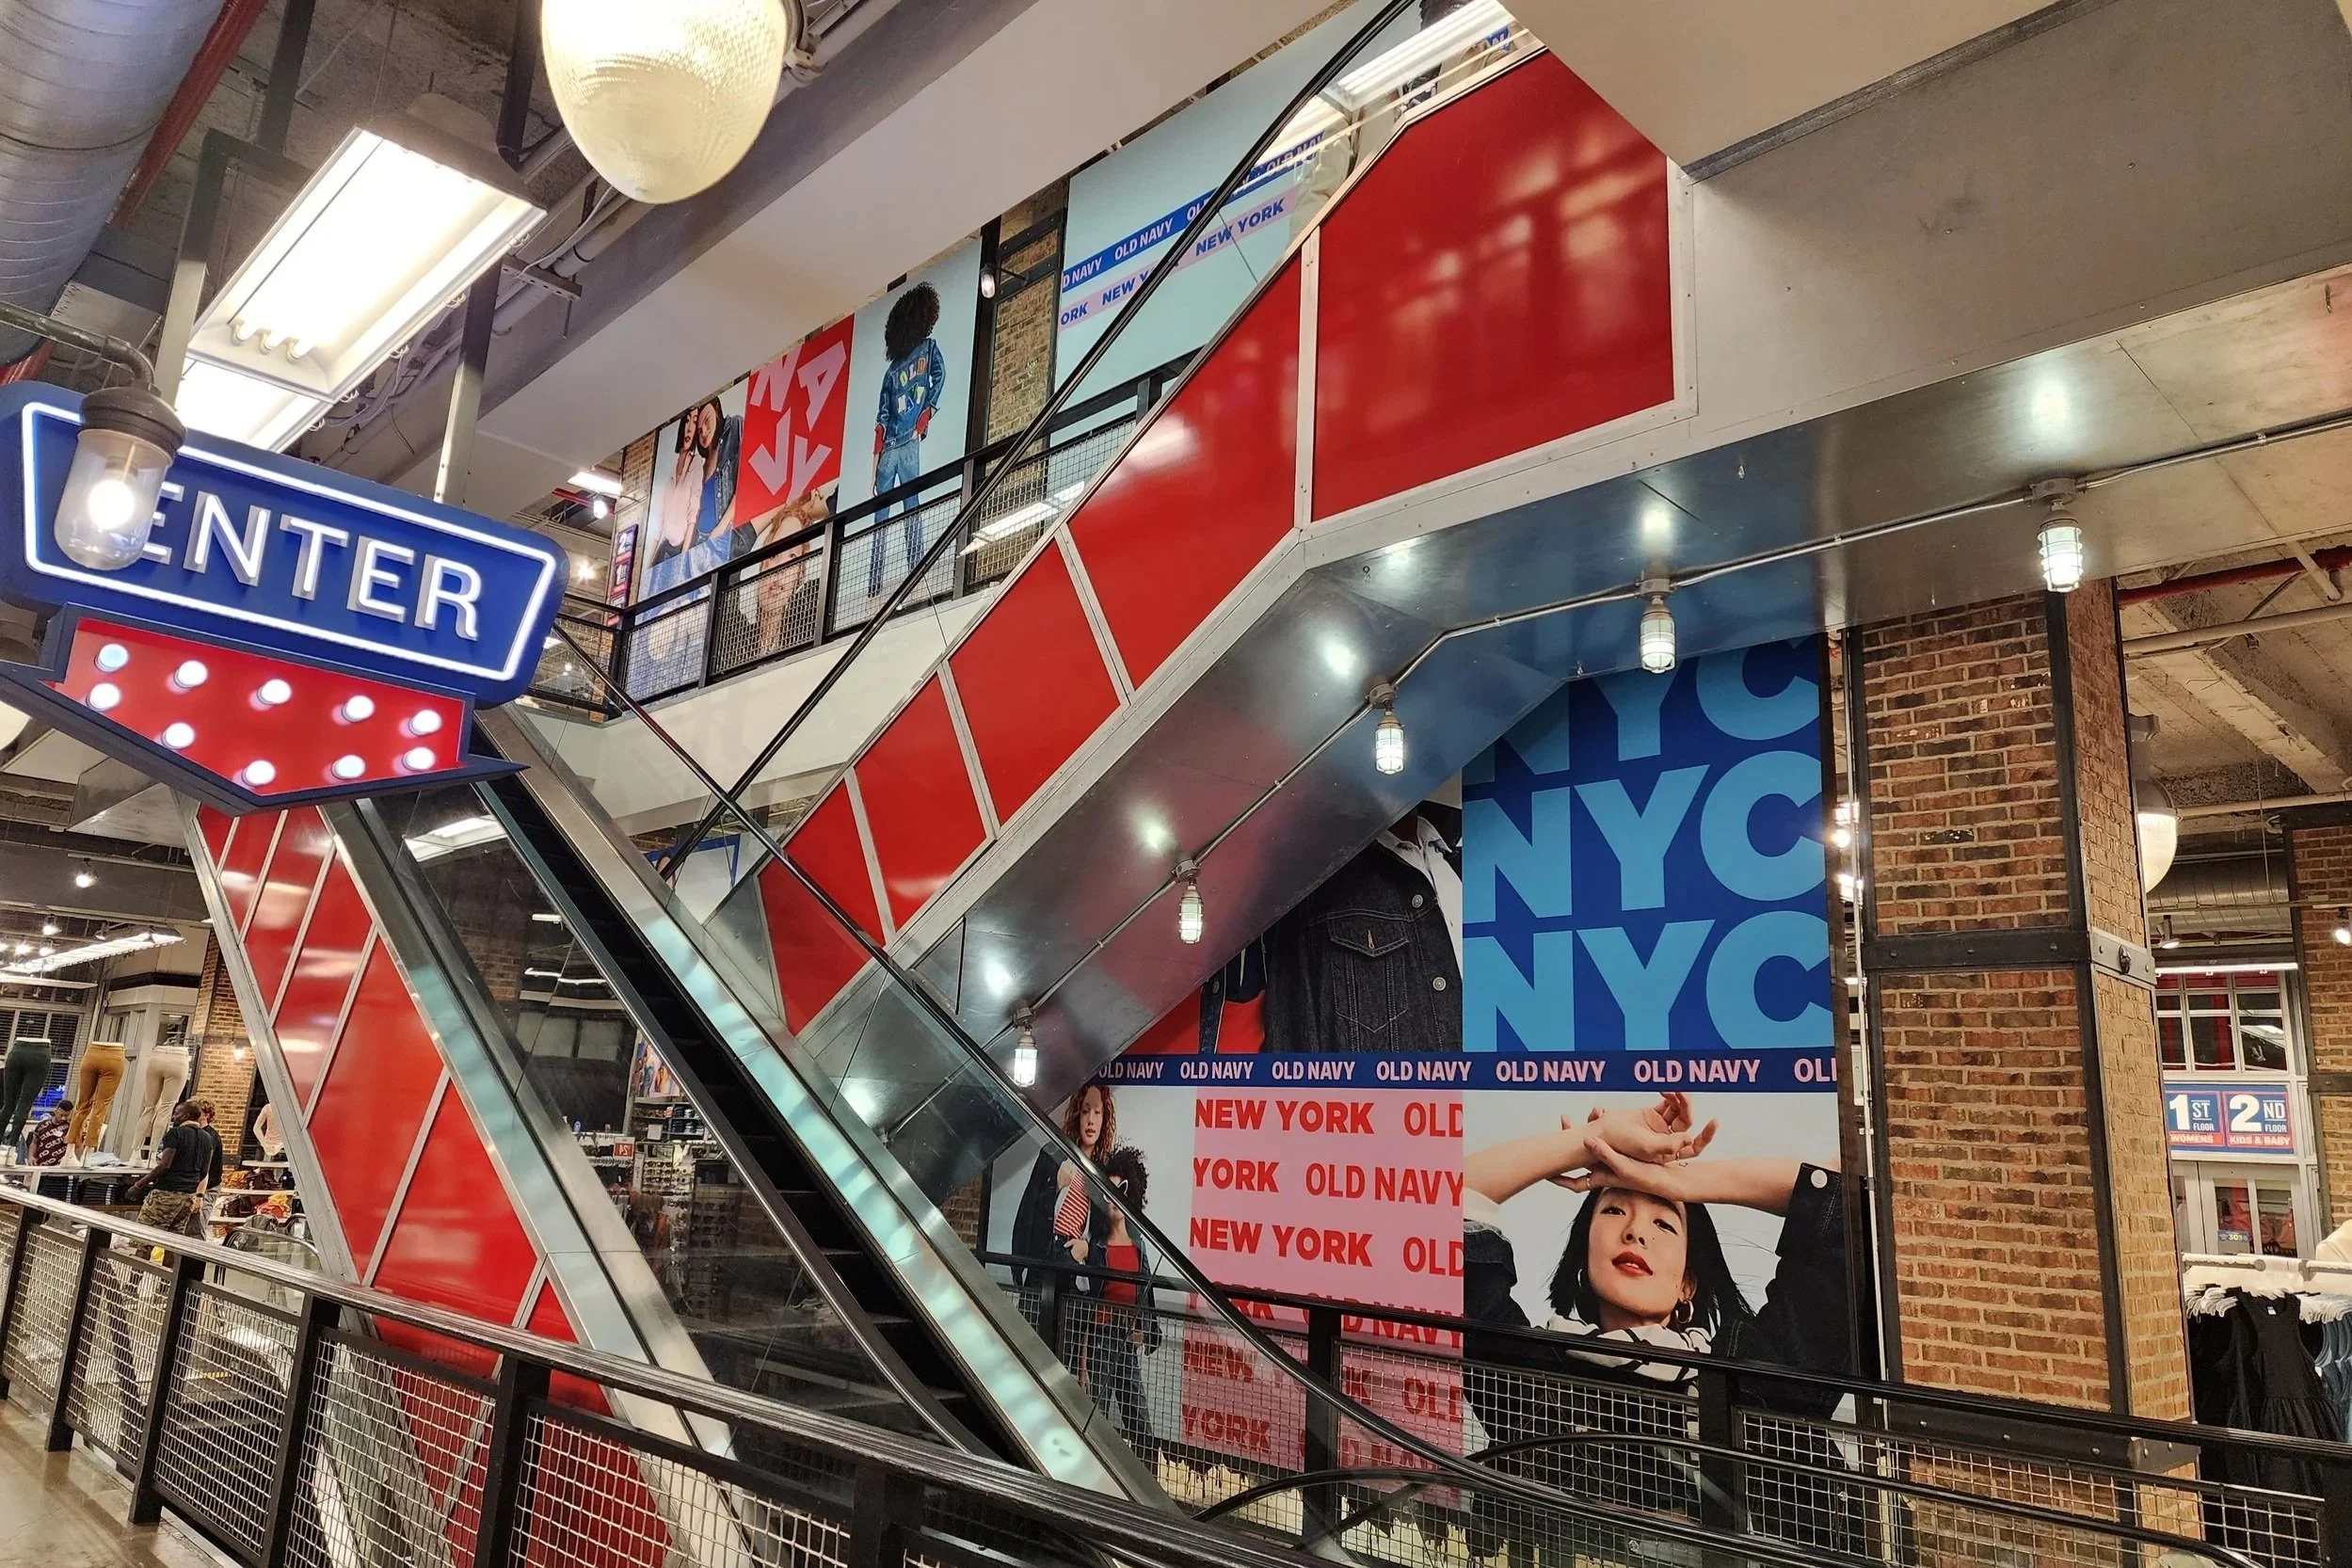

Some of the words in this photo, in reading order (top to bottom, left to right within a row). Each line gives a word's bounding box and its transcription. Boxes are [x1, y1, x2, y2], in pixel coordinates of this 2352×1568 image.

[1195, 228, 1234, 257] NEW
[1236, 198, 1285, 234] YORK
[1071, 257, 1102, 283] NAVY
[1114, 238, 1138, 261] OLD
[1139, 217, 1174, 248] NAVY
[1102, 278, 1136, 306] NEW
[1463, 750, 1827, 924] NYC
[1463, 910, 1834, 1052] NYC
[1126, 1062, 1164, 1079] NAVY
[1179, 1061, 1208, 1080] OLD
[1211, 1061, 1255, 1080] NAVY
[1272, 1062, 1304, 1080] OLD
[1307, 1062, 1355, 1080] NAVY
[1376, 1061, 1413, 1081] OLD
[1417, 1061, 1472, 1082] NAVY
[1496, 1061, 1538, 1082] OLD
[1543, 1061, 1607, 1082] NAVY
[1633, 1060, 1683, 1082] OLD
[1689, 1059, 1761, 1082] NAVY
[1194, 1098, 1267, 1130] NEW
[1275, 1100, 1375, 1135] YORK
[1403, 1102, 1464, 1138] OLD
[2168, 1094, 2190, 1130] 1
[2191, 1102, 2211, 1119] ST
[2193, 1123, 2215, 1131] FLOOR
[2229, 1094, 2263, 1132] 2
[2263, 1103, 2286, 1119] ND
[2264, 1124, 2287, 1132] FLOOR
[2229, 1135, 2253, 1144] KIDS
[2255, 1135, 2263, 1144] &
[2264, 1135, 2291, 1145] BABY
[1192, 1157, 1280, 1193] YORK
[1305, 1162, 1365, 1199] OLD
[1374, 1167, 1464, 1207] NAVY
[1190, 1217, 1263, 1255] NEW
[1271, 1224, 1374, 1269] YORK
[1402, 1237, 1464, 1278] OLD
[1182, 1403, 1271, 1454] YORK
